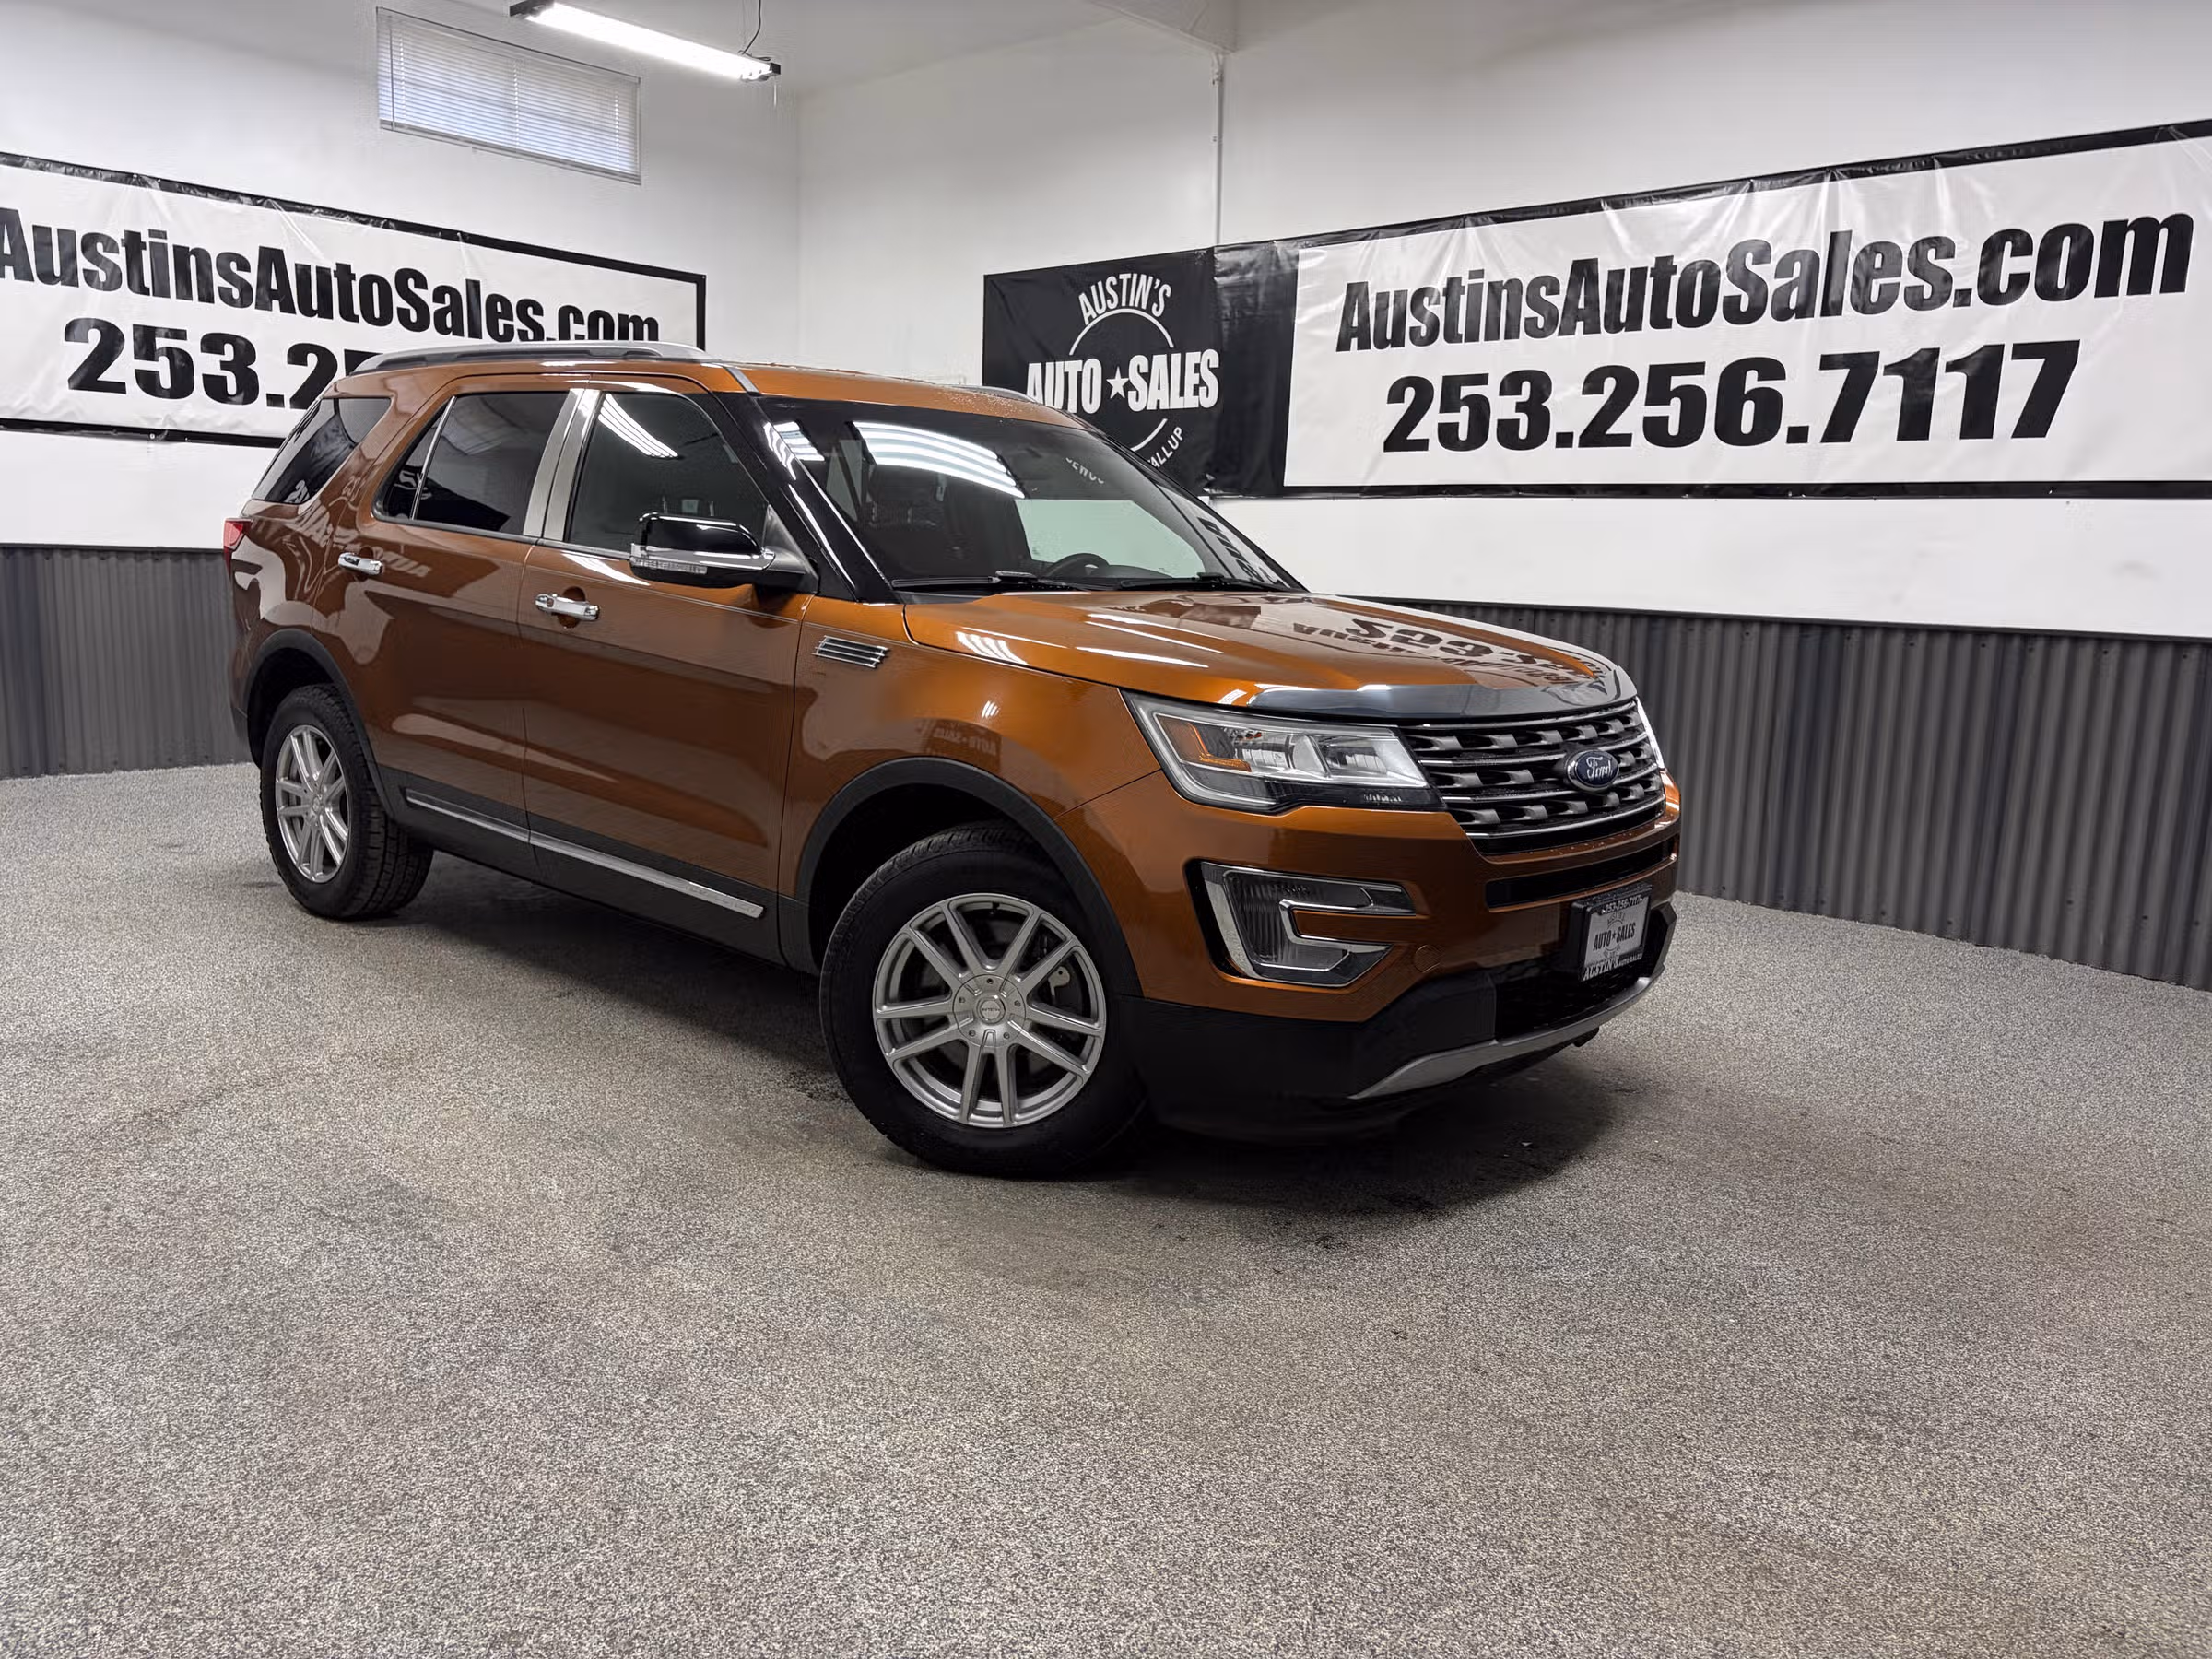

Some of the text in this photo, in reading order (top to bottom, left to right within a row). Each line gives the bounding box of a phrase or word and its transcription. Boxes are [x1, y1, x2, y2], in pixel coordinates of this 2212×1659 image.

[1078, 273, 1171, 325] AUSTIN'S
[1336, 212, 2194, 353] AustinsAutoSales.com
[1026, 348, 1219, 414] AUTO SALES
[1382, 339, 2080, 453] 253.256.7117
[1148, 427, 1183, 468] ALLUP
[1586, 756, 1614, 779] Ford
[1593, 922, 1636, 950] AUTO SALES
